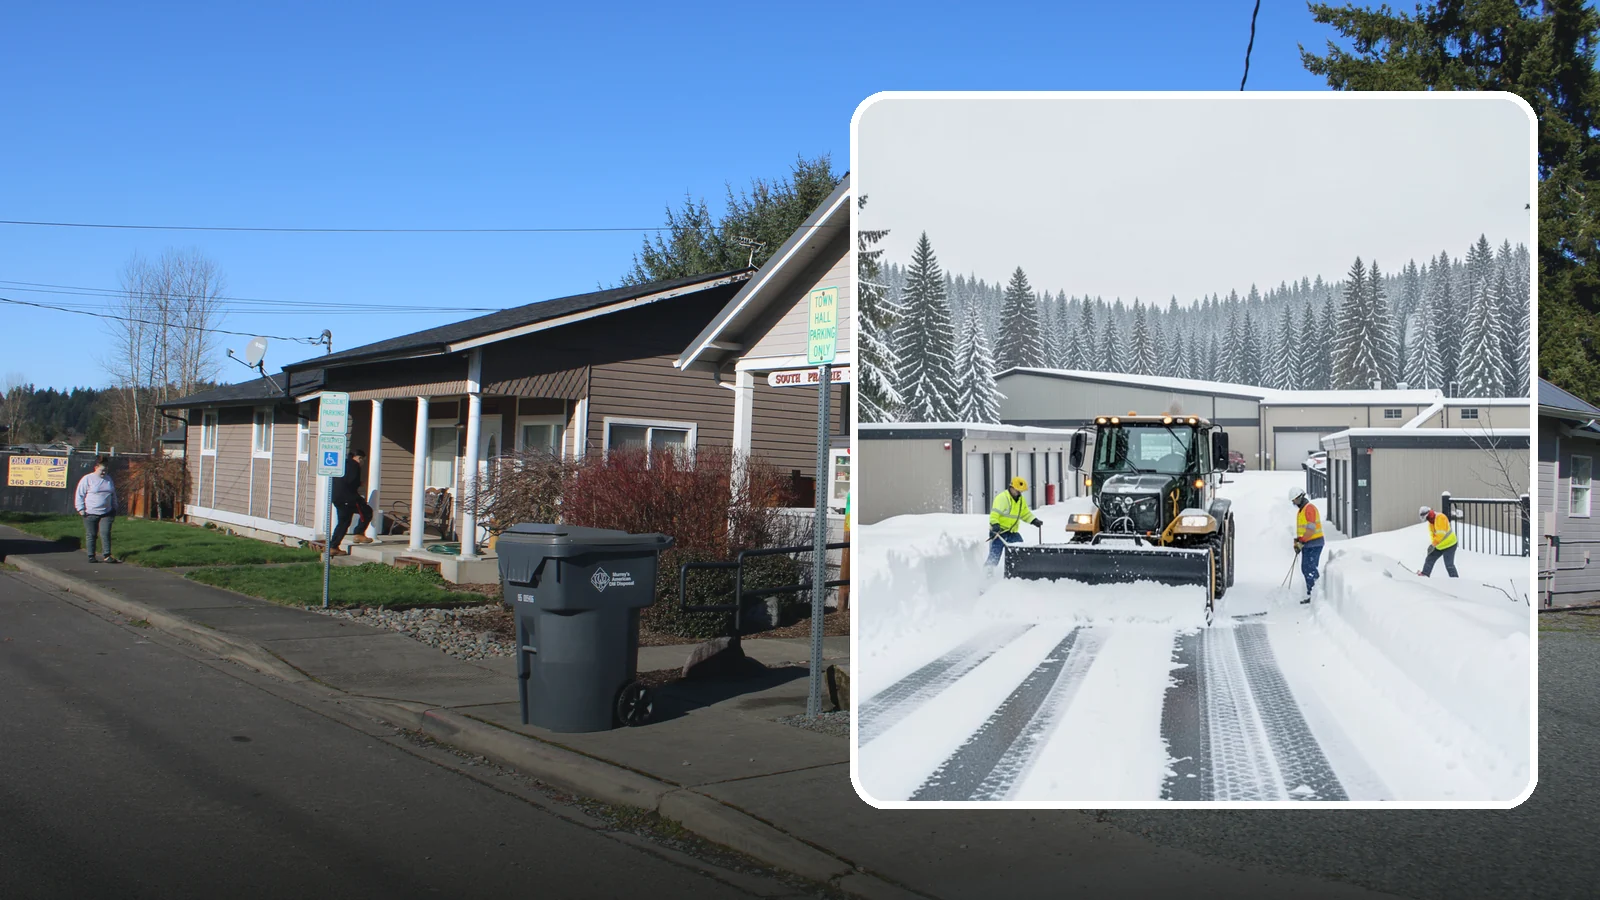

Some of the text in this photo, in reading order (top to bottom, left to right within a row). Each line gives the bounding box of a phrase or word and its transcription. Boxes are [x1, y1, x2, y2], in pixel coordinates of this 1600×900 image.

[815, 295, 833, 308] TOWN
[815, 312, 831, 324] HALL
[810, 326, 836, 341] PARKING
[814, 345, 830, 357] ONLY
[776, 374, 800, 384] SOUTH
